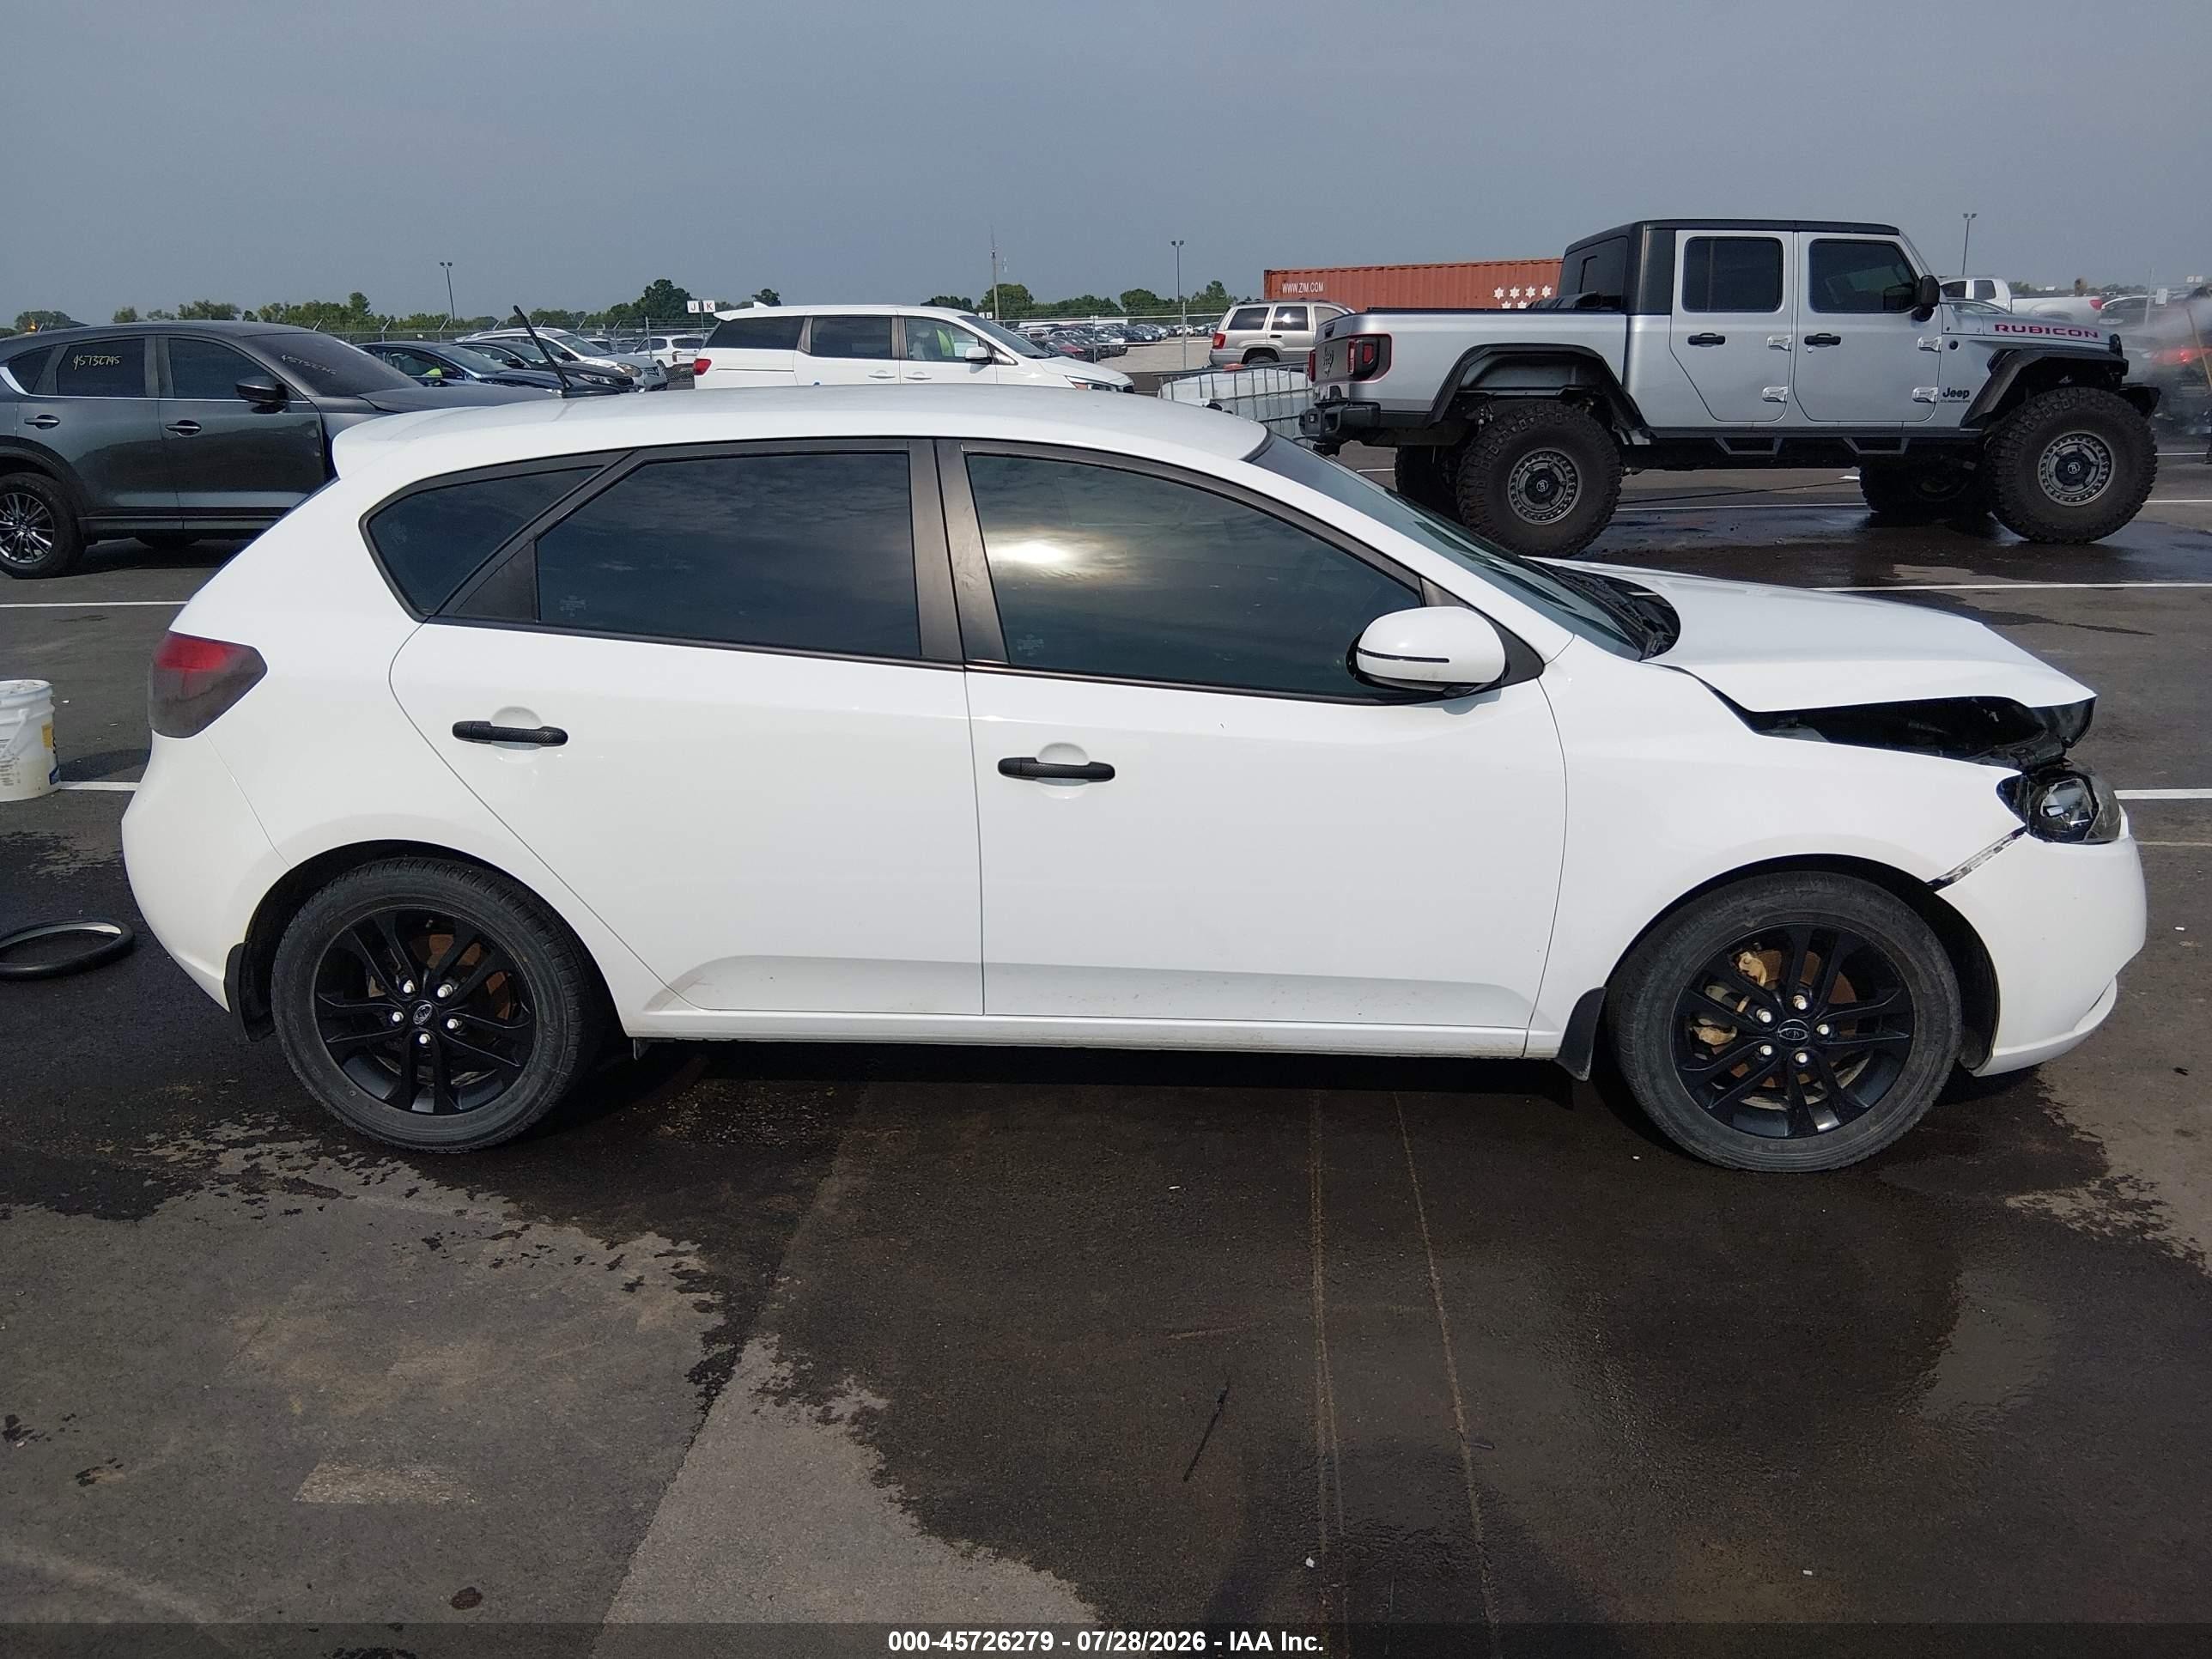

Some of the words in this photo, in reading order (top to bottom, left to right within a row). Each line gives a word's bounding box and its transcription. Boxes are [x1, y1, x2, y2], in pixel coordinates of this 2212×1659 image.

[1282, 282, 1323, 294] WWW.ZIM.COM
[690, 302, 696, 311] J
[707, 302, 714, 311] K
[1994, 324, 2099, 338] RUBICON
[1942, 386, 1970, 400] Jeep
